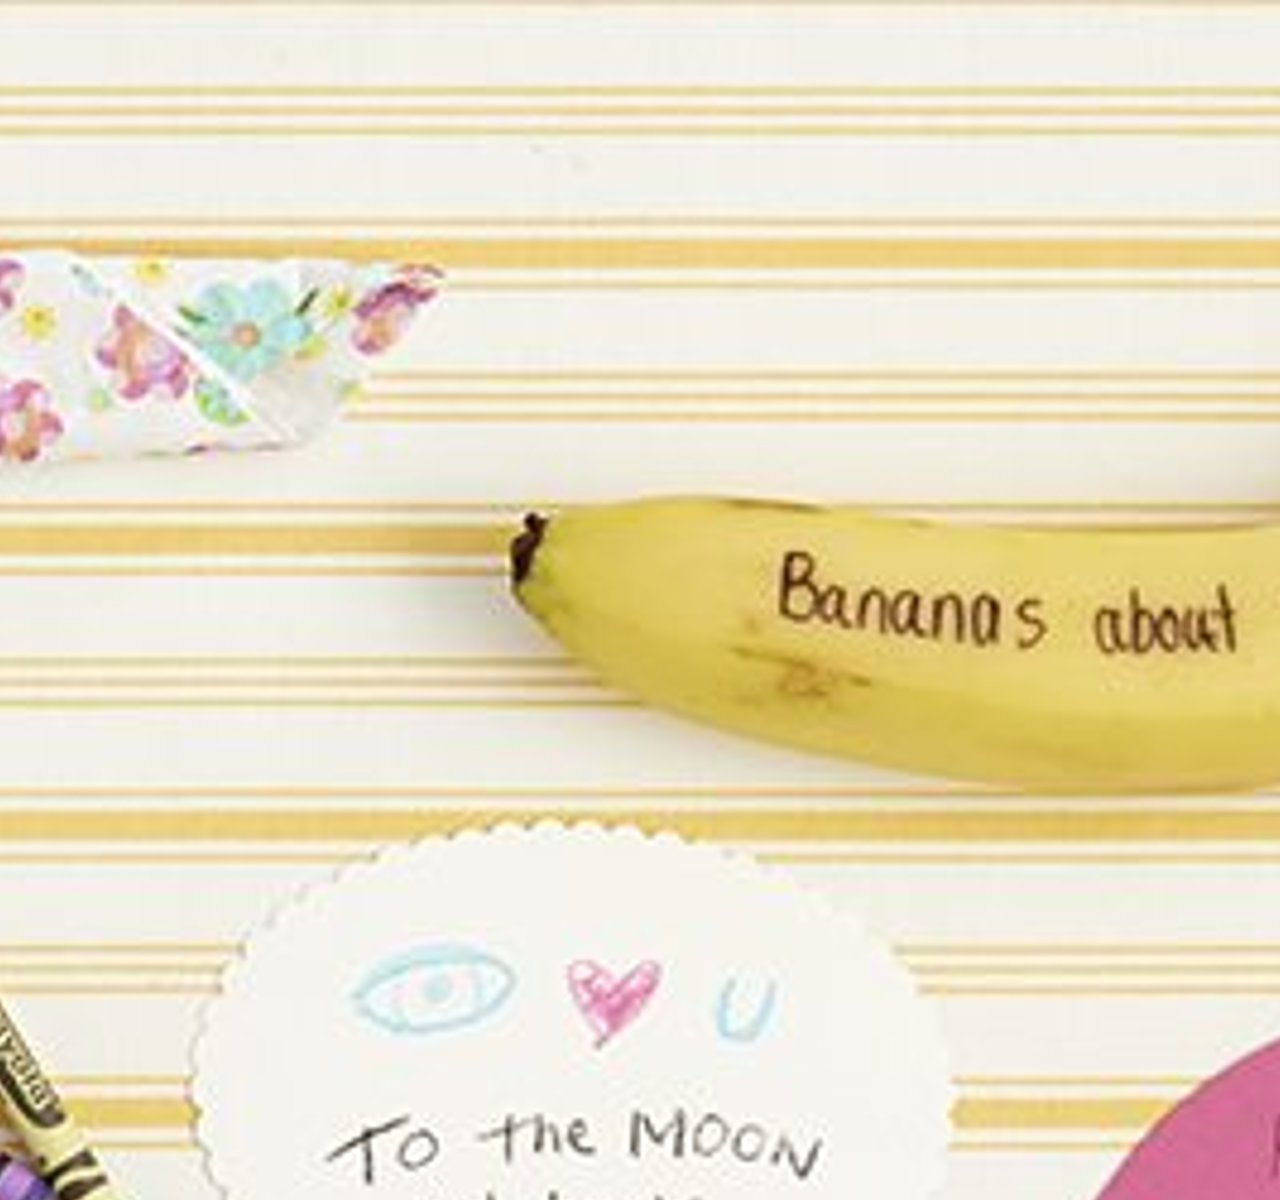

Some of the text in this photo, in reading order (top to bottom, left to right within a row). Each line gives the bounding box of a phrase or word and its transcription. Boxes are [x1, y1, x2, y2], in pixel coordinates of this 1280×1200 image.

[778, 550, 1047, 650] Bananas
[1094, 583, 1238, 655] about
[478, 1112, 598, 1164] the
[629, 1108, 823, 1181] MOON
